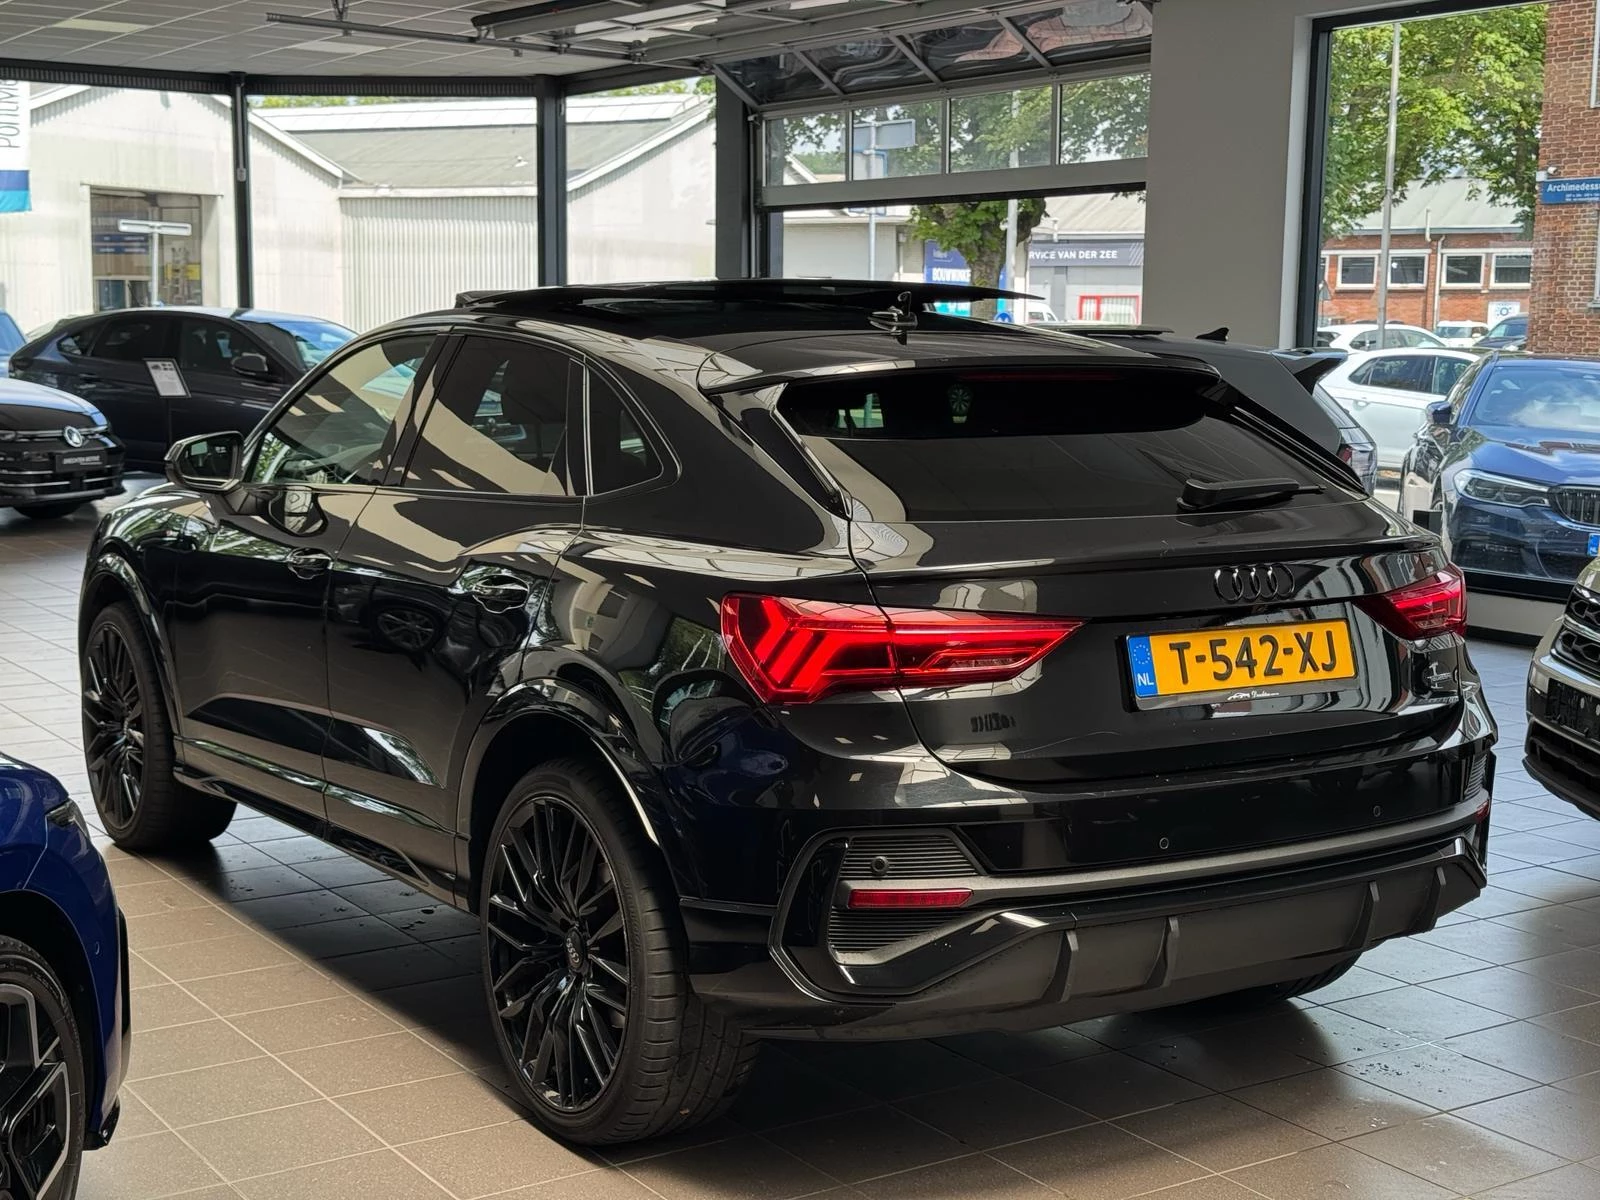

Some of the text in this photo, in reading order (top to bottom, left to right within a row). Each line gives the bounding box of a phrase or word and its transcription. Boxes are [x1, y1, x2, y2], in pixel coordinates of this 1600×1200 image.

[1057, 250, 1077, 259] VAN
[1078, 250, 1098, 259] DER
[1099, 250, 1118, 259] ZEE
[1137, 630, 1338, 686] NL T-542-XJ
